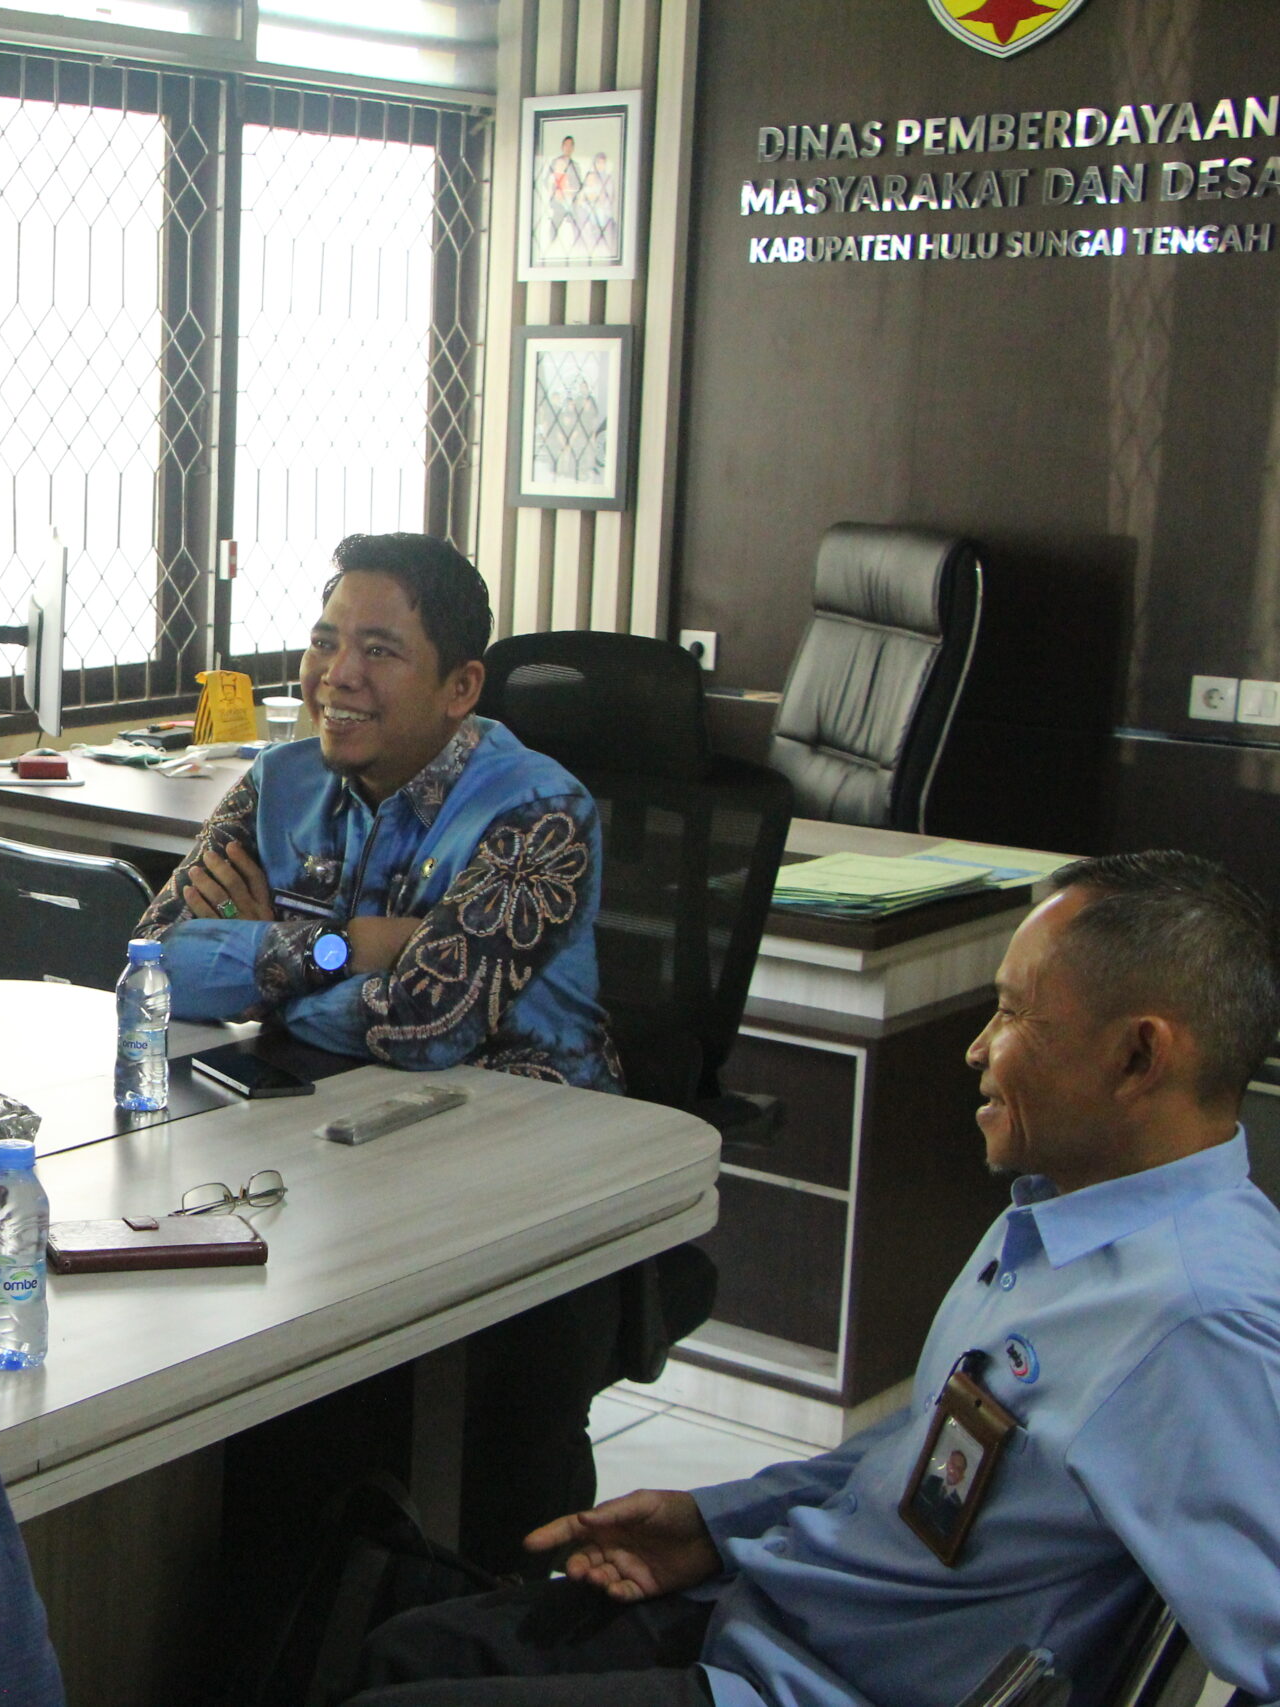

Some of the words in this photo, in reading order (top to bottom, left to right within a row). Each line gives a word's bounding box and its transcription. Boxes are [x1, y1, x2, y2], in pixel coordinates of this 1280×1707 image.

[757, 120, 884, 163] DINAS
[895, 95, 1280, 157] PEMBERDAYAAN
[740, 169, 1030, 216] MASYARAKAT
[1042, 163, 1145, 206] DAN
[1160, 156, 1280, 202] DESA
[749, 234, 912, 264] KABUPATEN
[918, 232, 999, 260] HULU
[1005, 227, 1127, 259] SUNGAI
[1133, 223, 1271, 256] TENGAH
